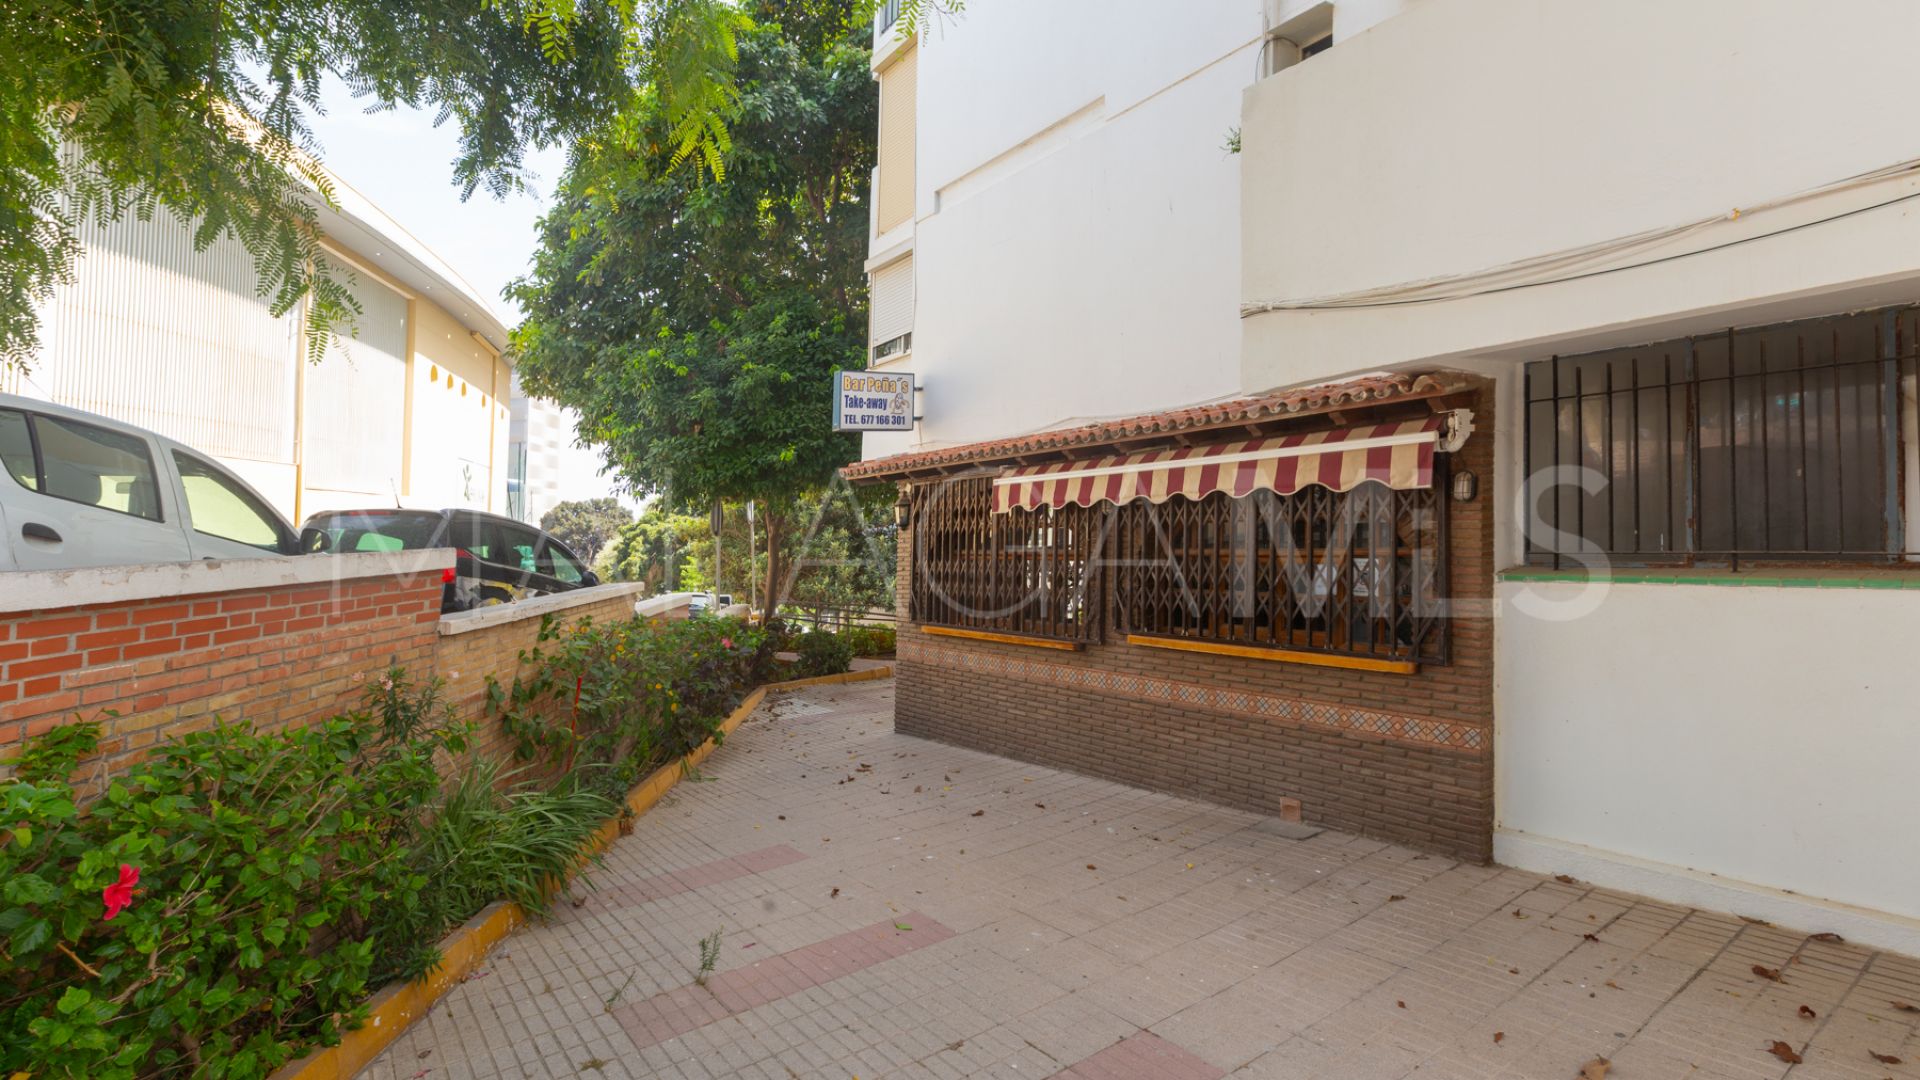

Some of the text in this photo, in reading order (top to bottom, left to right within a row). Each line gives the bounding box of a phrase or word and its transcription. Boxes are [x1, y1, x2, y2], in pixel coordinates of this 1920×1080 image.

[843, 375, 865, 391] Bar
[844, 394, 888, 411] Take-away
[844, 414, 906, 425] TEL. 677 166 301
